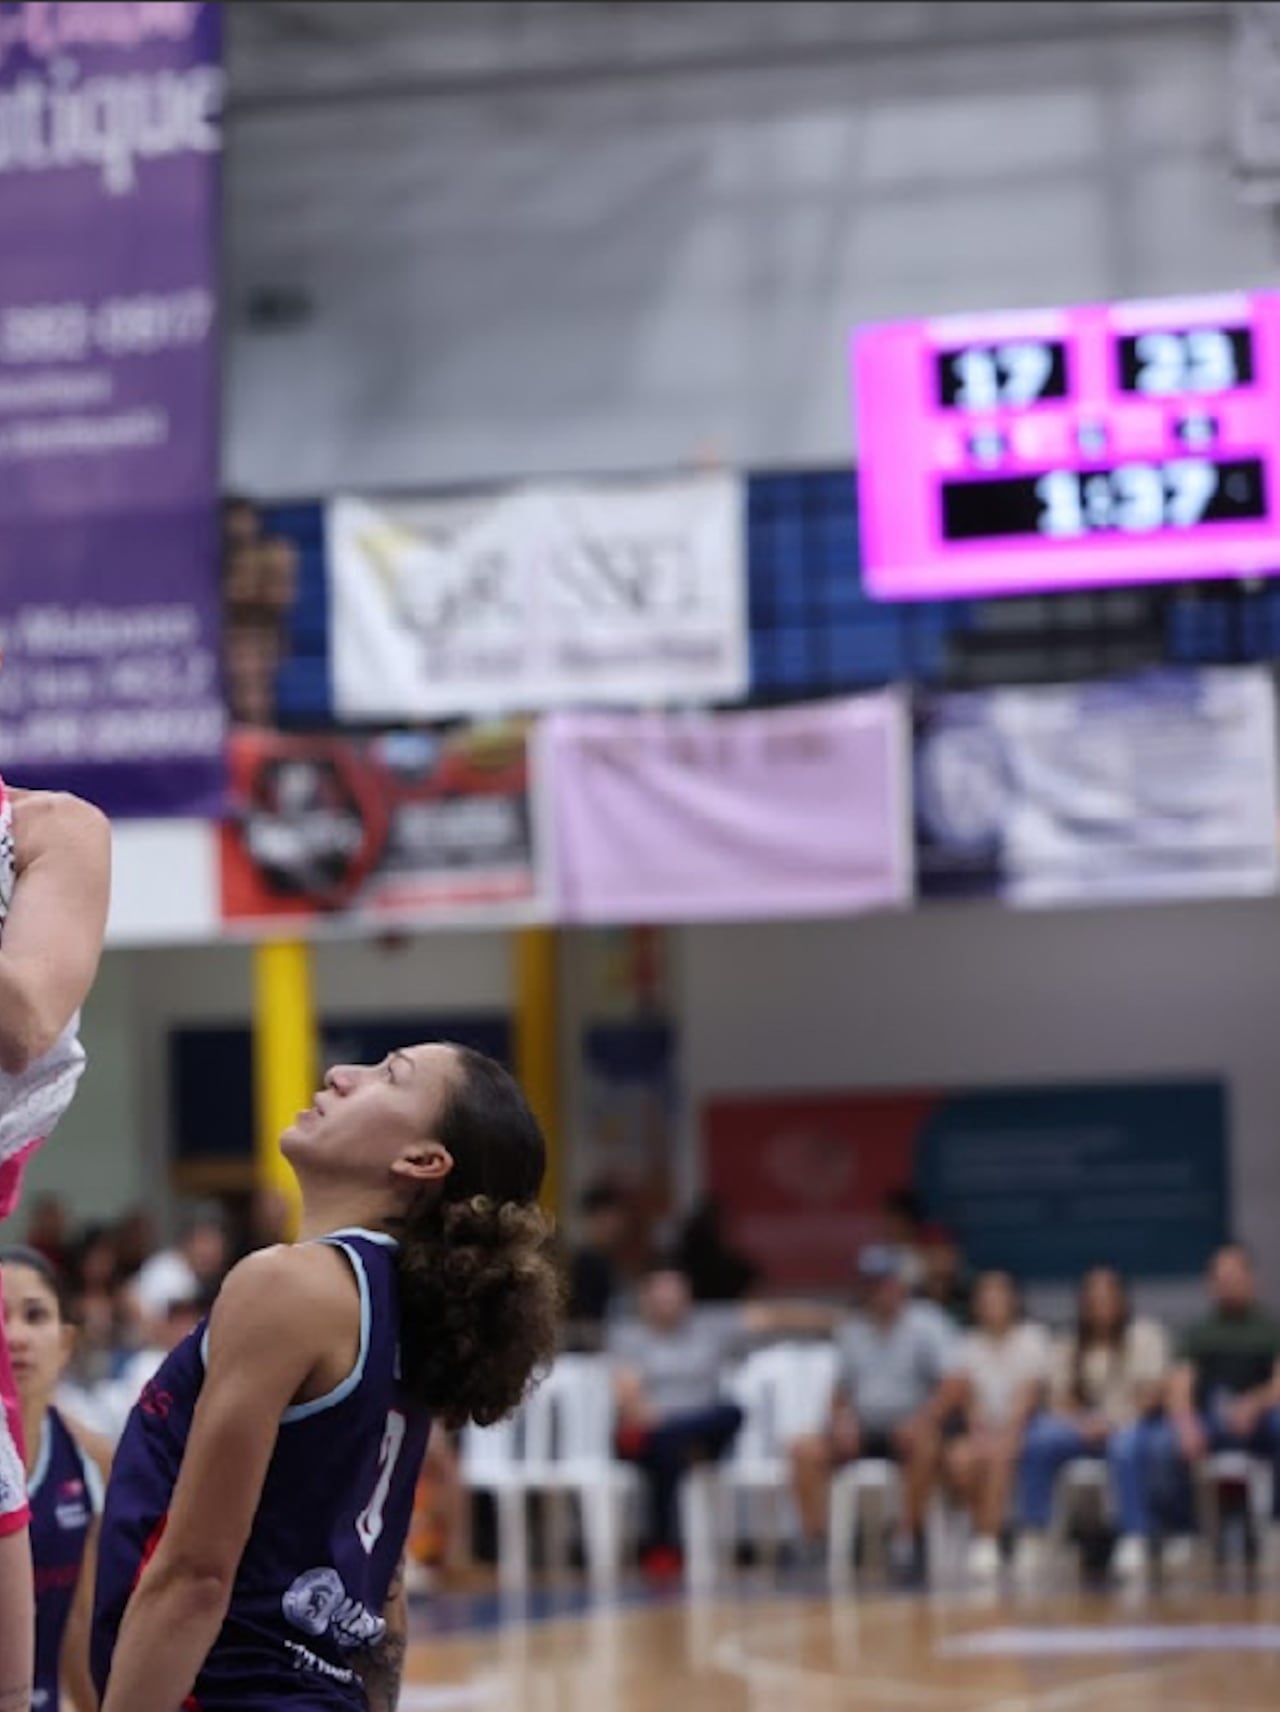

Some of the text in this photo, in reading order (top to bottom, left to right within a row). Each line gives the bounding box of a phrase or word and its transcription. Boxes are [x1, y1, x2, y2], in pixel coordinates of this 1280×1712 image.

[953, 344, 1054, 412] 17
[1136, 331, 1237, 396] 23
[1036, 461, 1220, 539] 1:37
